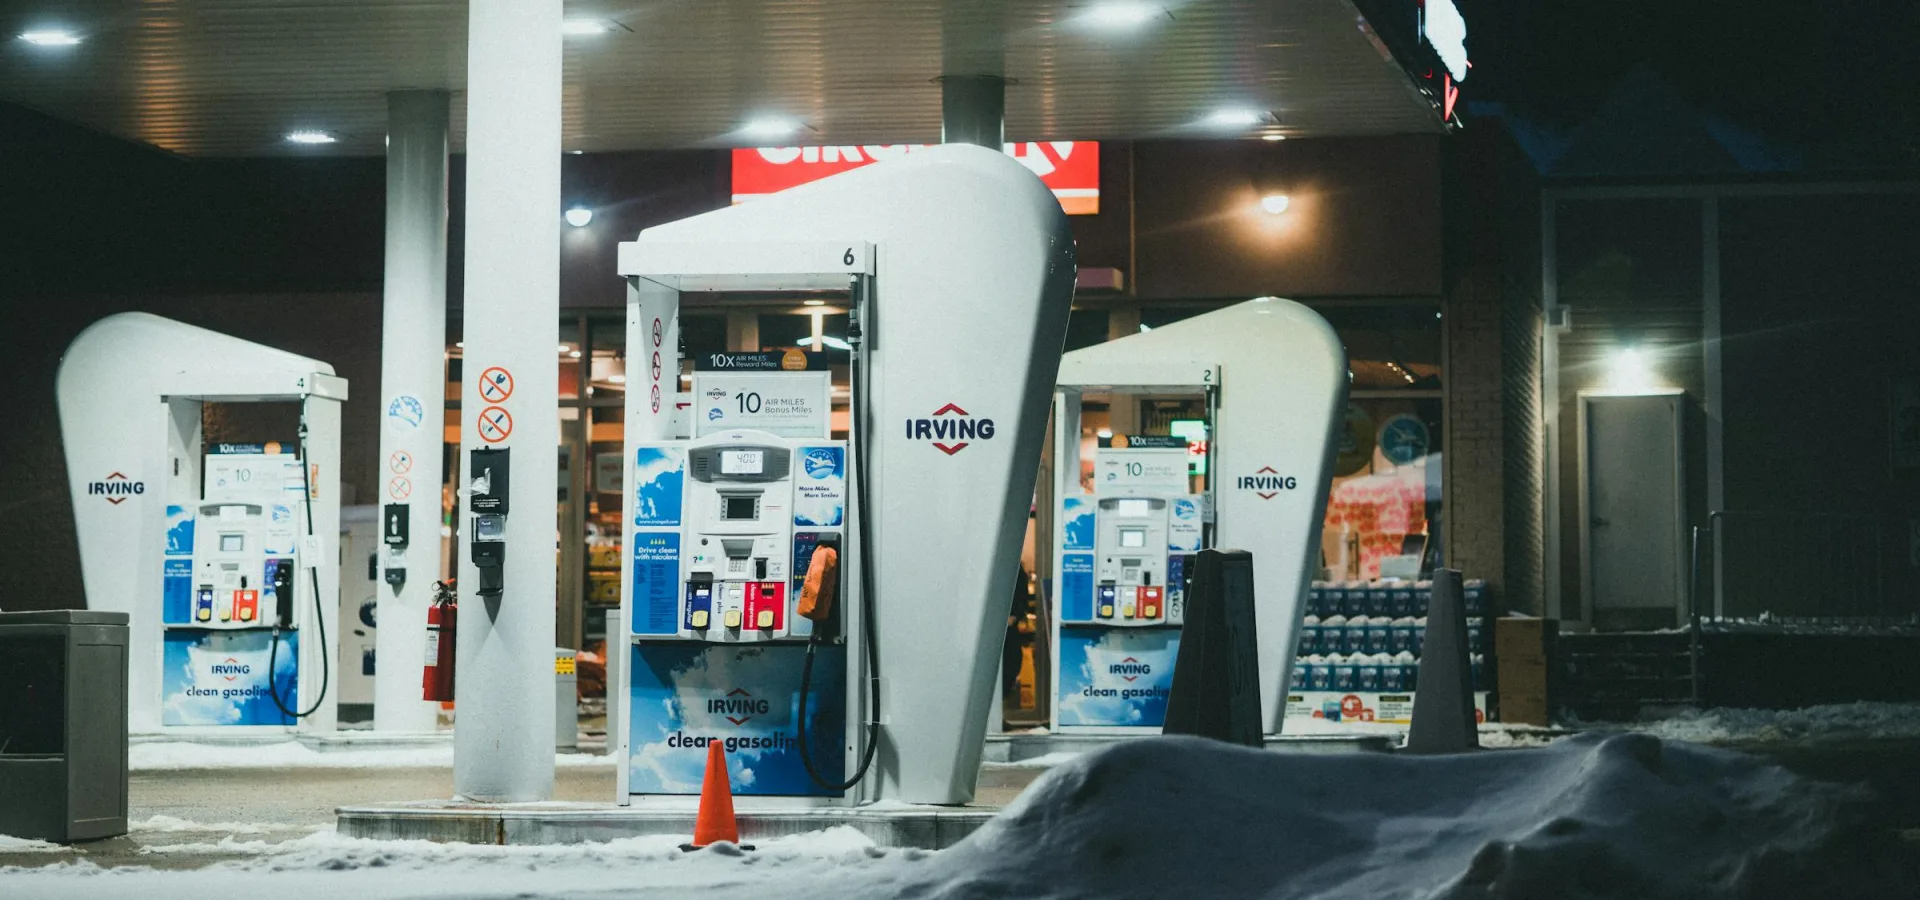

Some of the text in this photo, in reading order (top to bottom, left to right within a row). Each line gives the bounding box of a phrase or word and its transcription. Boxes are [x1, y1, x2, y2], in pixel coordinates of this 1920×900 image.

[844, 248, 855, 266] 6
[710, 353, 735, 368] 10x
[1204, 369, 1212, 382] 2
[297, 378, 304, 388] 4
[735, 392, 761, 414] 10
[780, 398, 805, 406] MILES
[765, 406, 812, 414] Bonus Miles
[907, 418, 995, 440] IRVING
[235, 469, 251, 482] 10
[1126, 462, 1143, 477] 10
[88, 481, 145, 495] IRVING
[1238, 476, 1297, 490] IRVING
[638, 546, 677, 554] Drive clean
[718, 583, 726, 601] clean
[685, 601, 693, 625] regular
[211, 665, 250, 674] IRVING
[1109, 664, 1151, 675] IRVING
[186, 685, 218, 696] clean
[1083, 685, 1169, 699] clean gasolin
[708, 699, 770, 715] IRVING
[725, 731, 796, 753] gasolin
